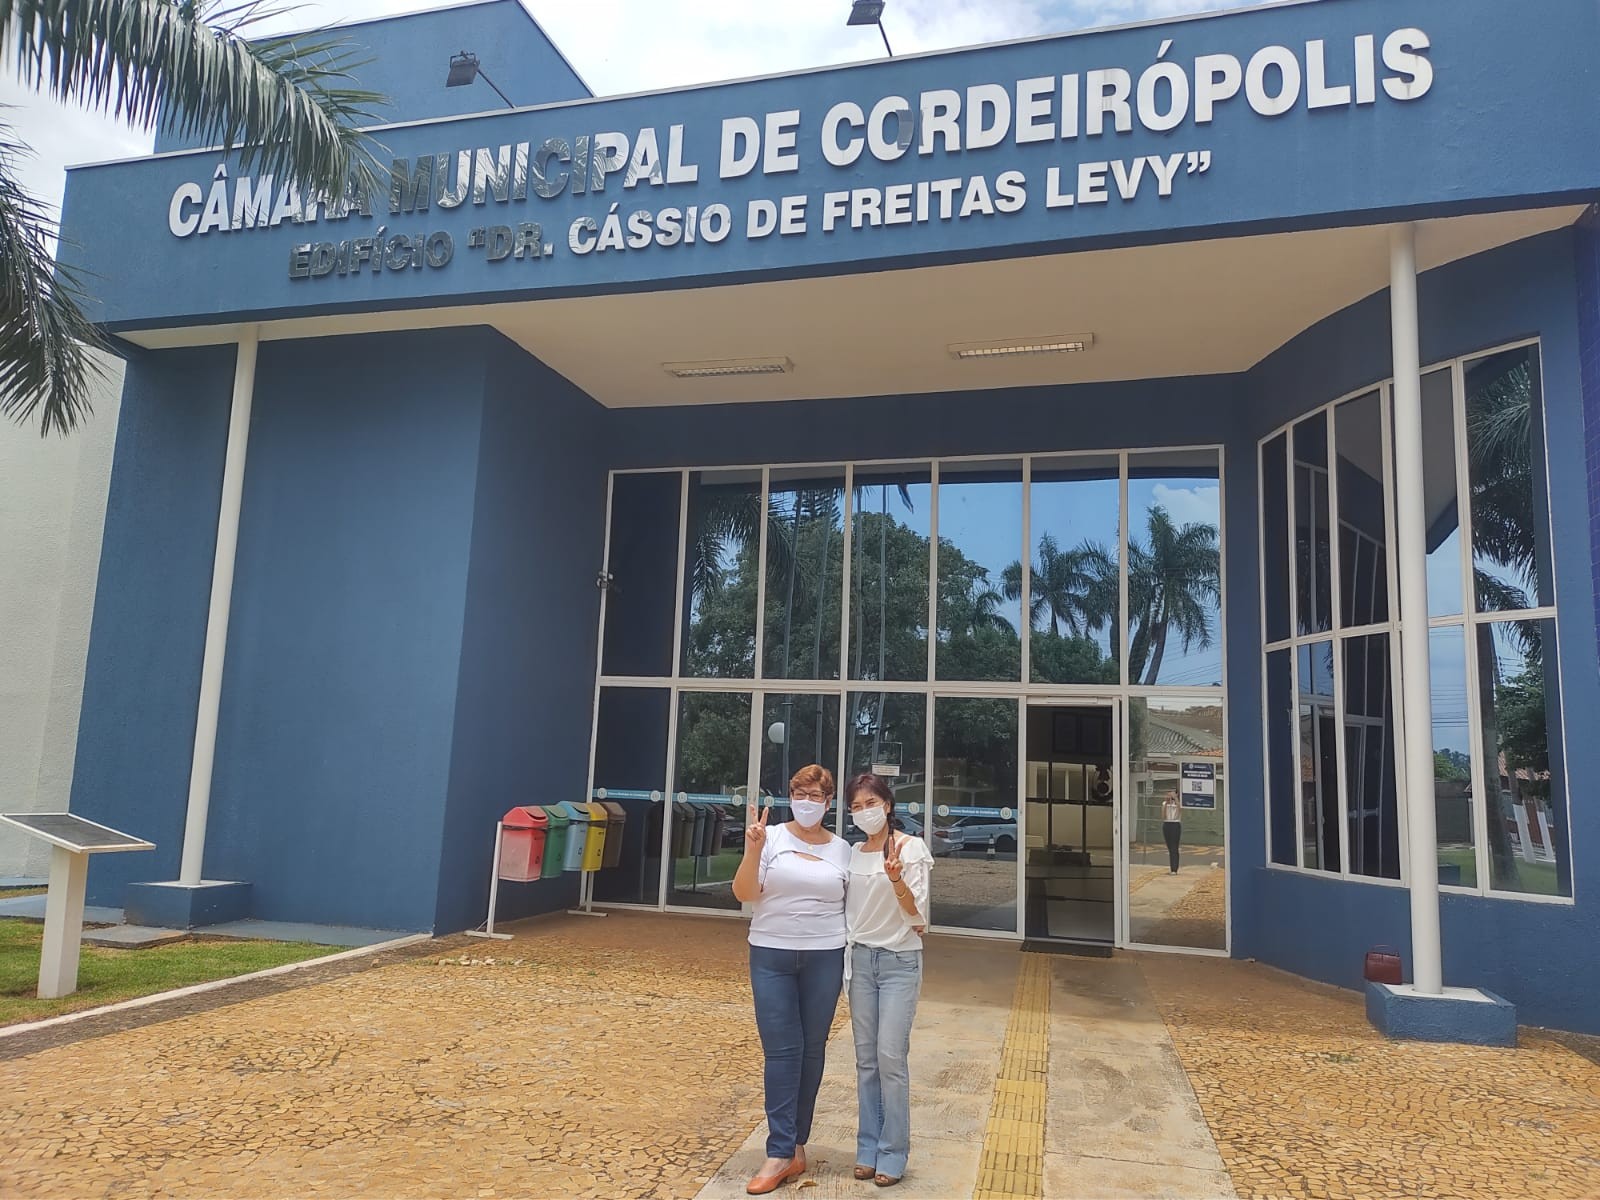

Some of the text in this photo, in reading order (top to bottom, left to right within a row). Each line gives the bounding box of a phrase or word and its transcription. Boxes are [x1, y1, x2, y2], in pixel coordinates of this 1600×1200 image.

[388, 124, 698, 214] MUNICIPAL
[720, 110, 800, 179] DE
[821, 28, 1434, 167] CORDEIRÓPOLIS
[289, 225, 453, 279] EDIFÍCIO
[568, 202, 732, 255] CÁSSIO
[747, 195, 807, 238] DE
[822, 178, 1027, 232] FREITAS
[1046, 151, 1211, 209] LEVY”
